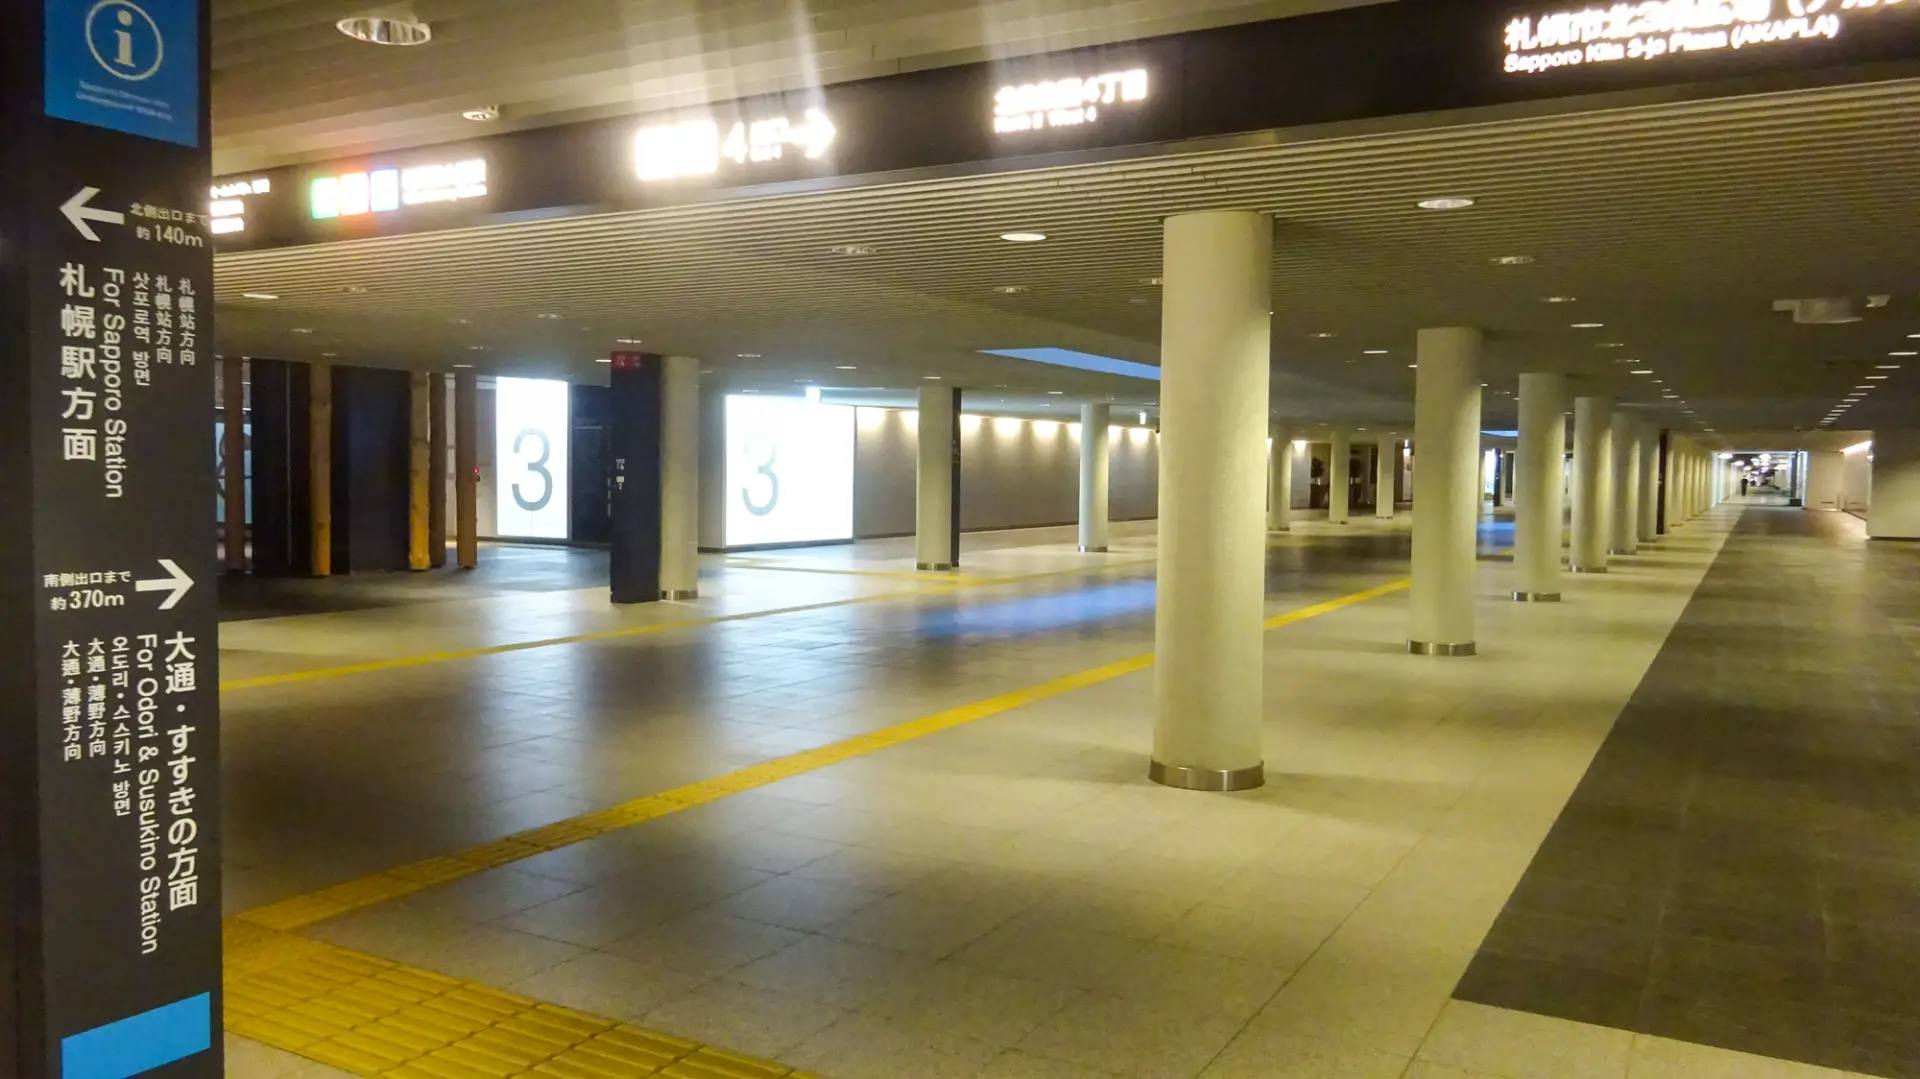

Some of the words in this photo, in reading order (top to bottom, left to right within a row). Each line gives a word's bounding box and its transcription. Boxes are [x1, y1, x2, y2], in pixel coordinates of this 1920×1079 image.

[1503, 49, 1583, 73] Sapporo
[103, 268, 124, 307] For
[133, 272, 150, 343] 삿포로역
[60, 262, 97, 461] 札幌駅方面
[100, 314, 125, 410] Sapporo
[133, 351, 150, 386] 방면
[105, 419, 127, 497] Station
[511, 427, 553, 511] 3
[742, 433, 779, 516] 3
[43, 571, 131, 590] 南側出口まで
[137, 634, 157, 671] For
[137, 678, 158, 738] Odori
[138, 746, 158, 762] &
[165, 631, 198, 911] 大通・すすきの方面
[139, 769, 160, 870] Susukino
[140, 876, 161, 954] Station
